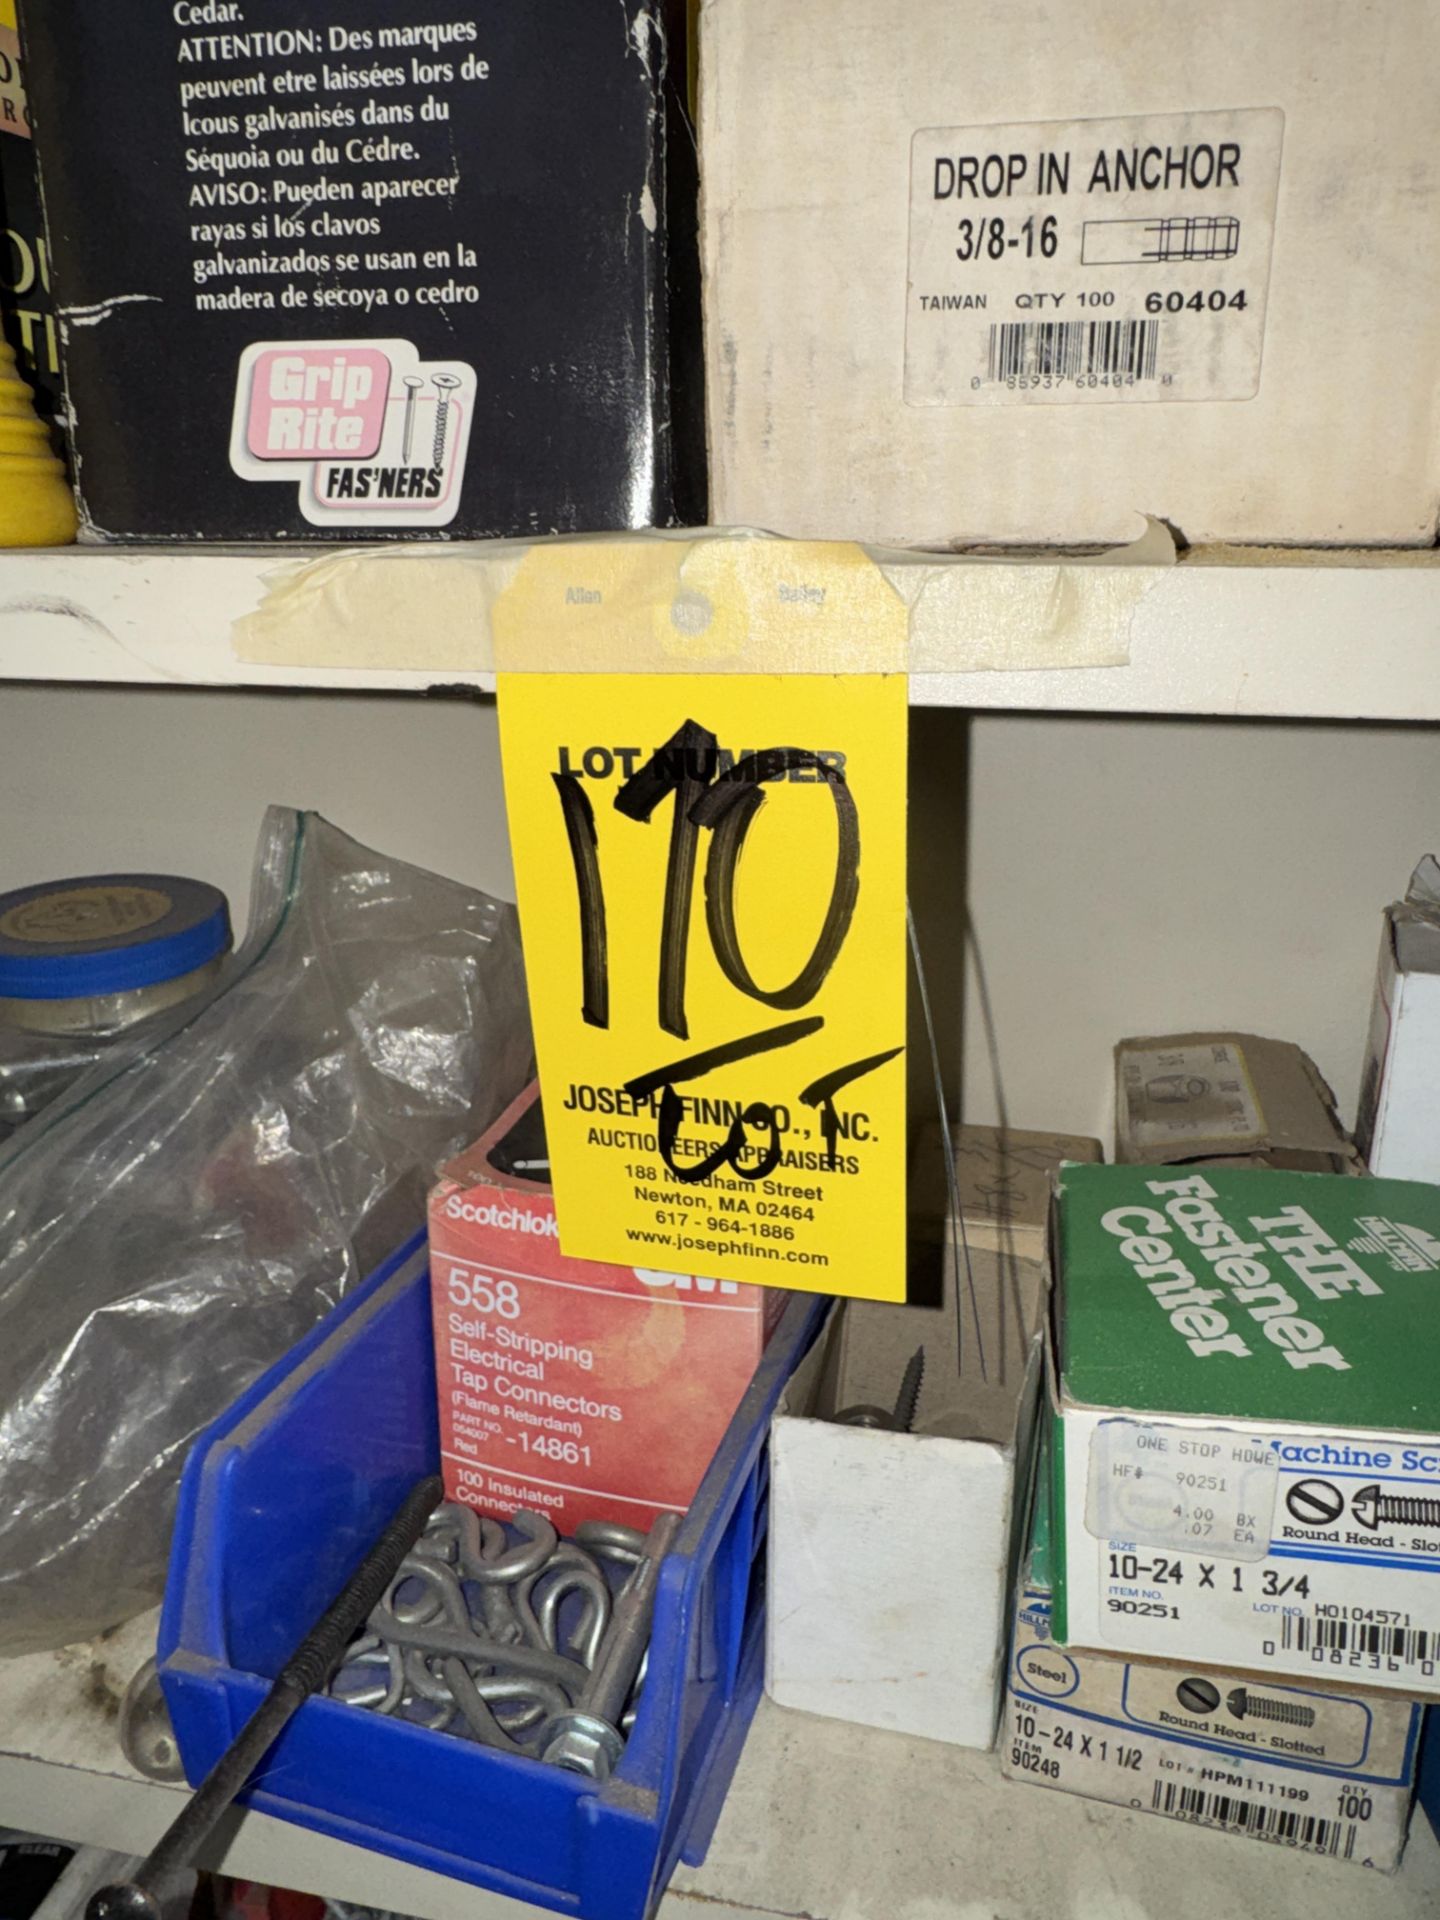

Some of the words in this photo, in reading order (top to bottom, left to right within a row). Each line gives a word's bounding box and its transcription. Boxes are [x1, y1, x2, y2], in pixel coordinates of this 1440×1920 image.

[173, 0, 244, 26] Cedar.
[177, 29, 322, 63] ATTENTION:
[328, 26, 373, 51] Des
[378, 21, 478, 52] marques
[180, 72, 267, 108] peuvent
[272, 68, 317, 94] etre
[322, 61, 405, 91] laissées
[411, 57, 454, 84] lors
[460, 53, 490, 80] de
[245, 102, 355, 140] galvanisés
[361, 99, 414, 125] dans
[420, 95, 449, 121] du
[185, 145, 270, 177] Séquoia
[276, 148, 304, 165] ou
[311, 139, 339, 165] du
[346, 135, 420, 163] Cédre.
[934, 154, 1027, 200] DROP
[1038, 152, 1069, 195] IN
[1088, 144, 1241, 193] ANCHOR
[189, 181, 268, 206] AVISO:
[273, 176, 354, 203] Pueden
[361, 177, 457, 206] aparecer
[191, 220, 246, 248] rayas
[252, 215, 268, 239] si
[275, 213, 305, 238] los
[311, 211, 381, 237] clavos
[956, 215, 1058, 261] 3/8-16
[193, 248, 330, 284] galvanizados
[336, 252, 359, 270] se
[365, 250, 416, 270] usan
[423, 250, 450, 268] en
[457, 242, 477, 267] la
[196, 286, 275, 310] madera
[281, 284, 307, 308] de
[313, 287, 388, 313] secoya
[395, 288, 409, 304] o
[416, 279, 479, 304] cedro
[920, 294, 987, 311] TAIWAN
[1015, 292, 1066, 309] QTY
[1076, 291, 1115, 307] 100
[1145, 289, 1248, 313] 60404
[268, 356, 373, 409] Grip
[1007, 375, 1065, 389] 85937
[1075, 375, 1135, 389] 60404
[267, 407, 364, 450] Rite
[326, 467, 443, 499] FAS'NERS
[557, 746, 642, 780] LOT
[625, 1164, 657, 1181] 188
[763, 1180, 823, 1202] Street
[634, 1186, 712, 1211] Newton,
[719, 1196, 750, 1214] MA
[756, 1201, 815, 1222] 02464
[655, 1210, 688, 1227] 617
[707, 1217, 795, 1241] 964-1886
[626, 1229, 829, 1266] www.josephfinn.com
[1248, 1205, 1384, 1299] THE
[1101, 1206, 1253, 1358] Center
[1145, 1174, 1352, 1370] Fastener
[448, 1267, 521, 1319] 558
[448, 1313, 593, 1371] Self-Stripping
[450, 1338, 545, 1381] Electrical
[450, 1362, 488, 1393] Tap
[494, 1376, 623, 1421] Connectors
[452, 1390, 500, 1415] (Flame
[504, 1404, 583, 1438] Retardant)
[452, 1410, 481, 1427] PART
[454, 1437, 478, 1455] Red
[505, 1431, 591, 1467] -14861
[1137, 1434, 1168, 1452] ONE
[1179, 1440, 1221, 1458] STOP
[456, 1469, 484, 1488] 100
[488, 1477, 565, 1508] Insulated
[1176, 1471, 1228, 1492] 90251
[1172, 1504, 1214, 1521] 4.00
[1237, 1513, 1256, 1528] BX
[1184, 1522, 1213, 1536] .07
[1234, 1529, 1255, 1544] EA
[1109, 1541, 1136, 1552] SIZE
[1282, 1525, 1340, 1543] Round
[1345, 1529, 1394, 1548] Head
[1109, 1553, 1183, 1585] 10-24
[1199, 1562, 1215, 1589] X
[1233, 1566, 1243, 1592] 1
[1262, 1570, 1310, 1599] 3/4
[1109, 1585, 1139, 1598] ITEM
[1142, 1588, 1164, 1600] NO.
[1107, 1598, 1180, 1620] 90251
[1253, 1602, 1279, 1614] LOT
[1263, 1641, 1274, 1656] 0
[1027, 1662, 1067, 1684] Steel
[1014, 1699, 1038, 1714] SIZE
[1014, 1738, 1042, 1754] ITEM
[1158, 1710, 1209, 1733] Round
[1214, 1724, 1257, 1744] Head
[1270, 1735, 1325, 1756] Slotted
[1011, 1747, 1060, 1779] 90248
[1080, 1734, 1093, 1758] X
[1100, 1740, 1108, 1761] 1
[1116, 1745, 1143, 1771] 1/2
[1201, 1767, 1310, 1801] HPM111199
[1337, 1794, 1373, 1821] 100
